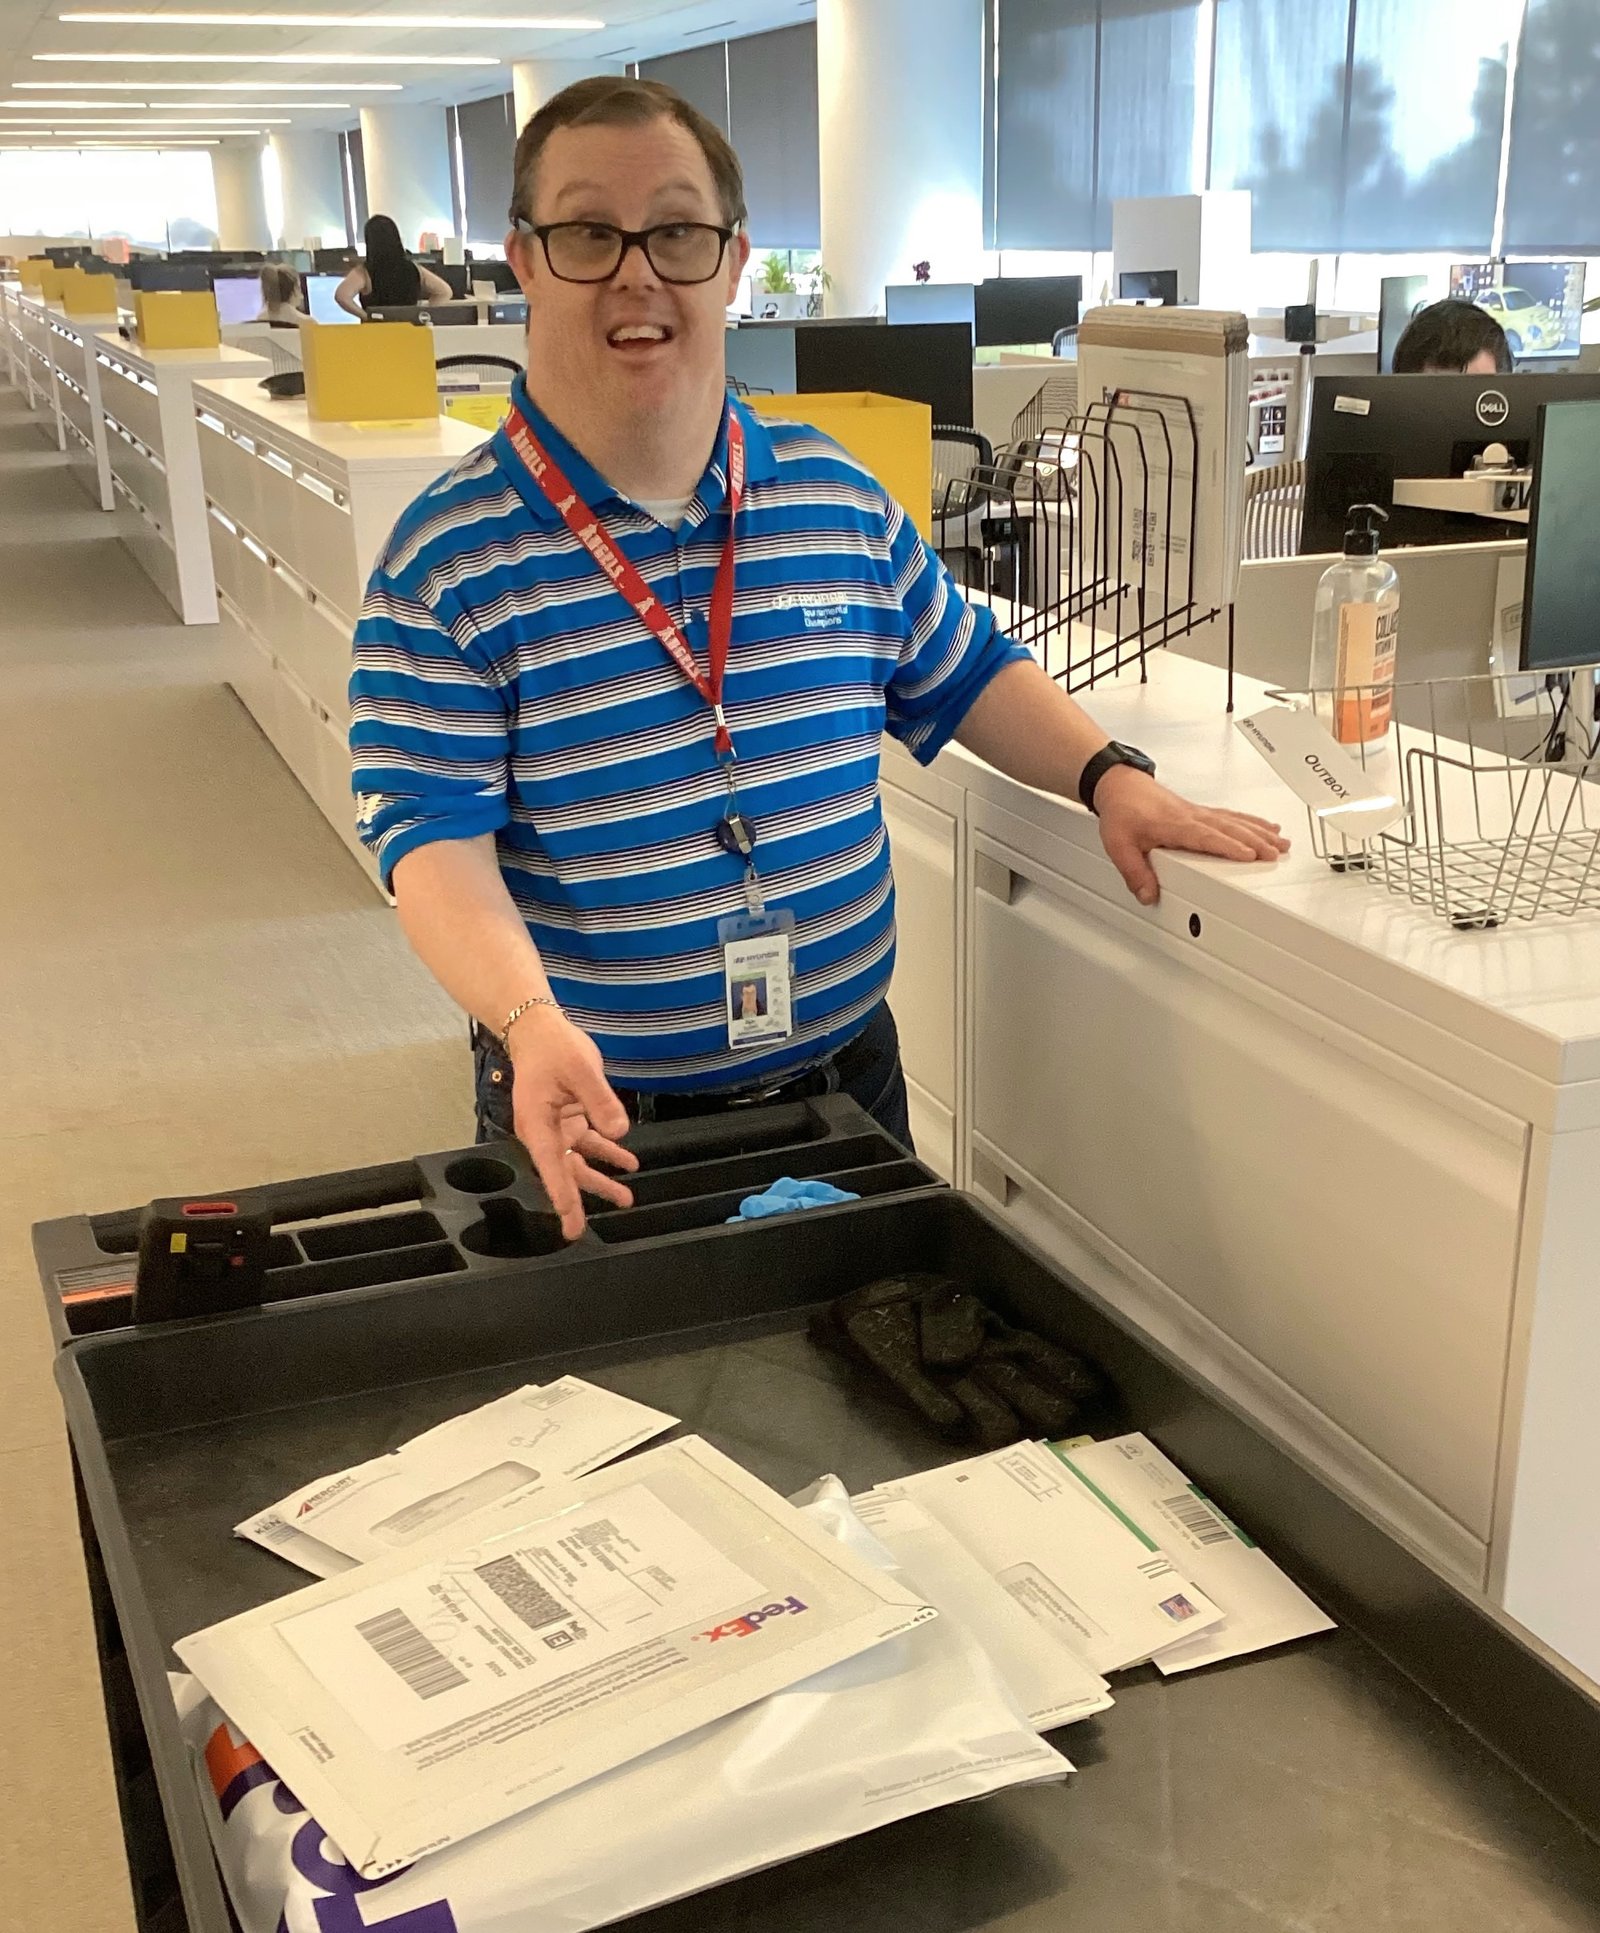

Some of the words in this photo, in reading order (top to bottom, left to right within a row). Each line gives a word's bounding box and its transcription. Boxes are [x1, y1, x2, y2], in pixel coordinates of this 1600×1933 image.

[1480, 402, 1505, 414] DELL
[511, 426, 547, 479] ANGELS
[579, 522, 625, 580] ANGELS
[657, 626, 703, 681] ANGELS
[1304, 754, 1351, 799] OUTBOX
[306, 1475, 353, 1504] MERCURY
[700, 1596, 809, 1644] FedEx
